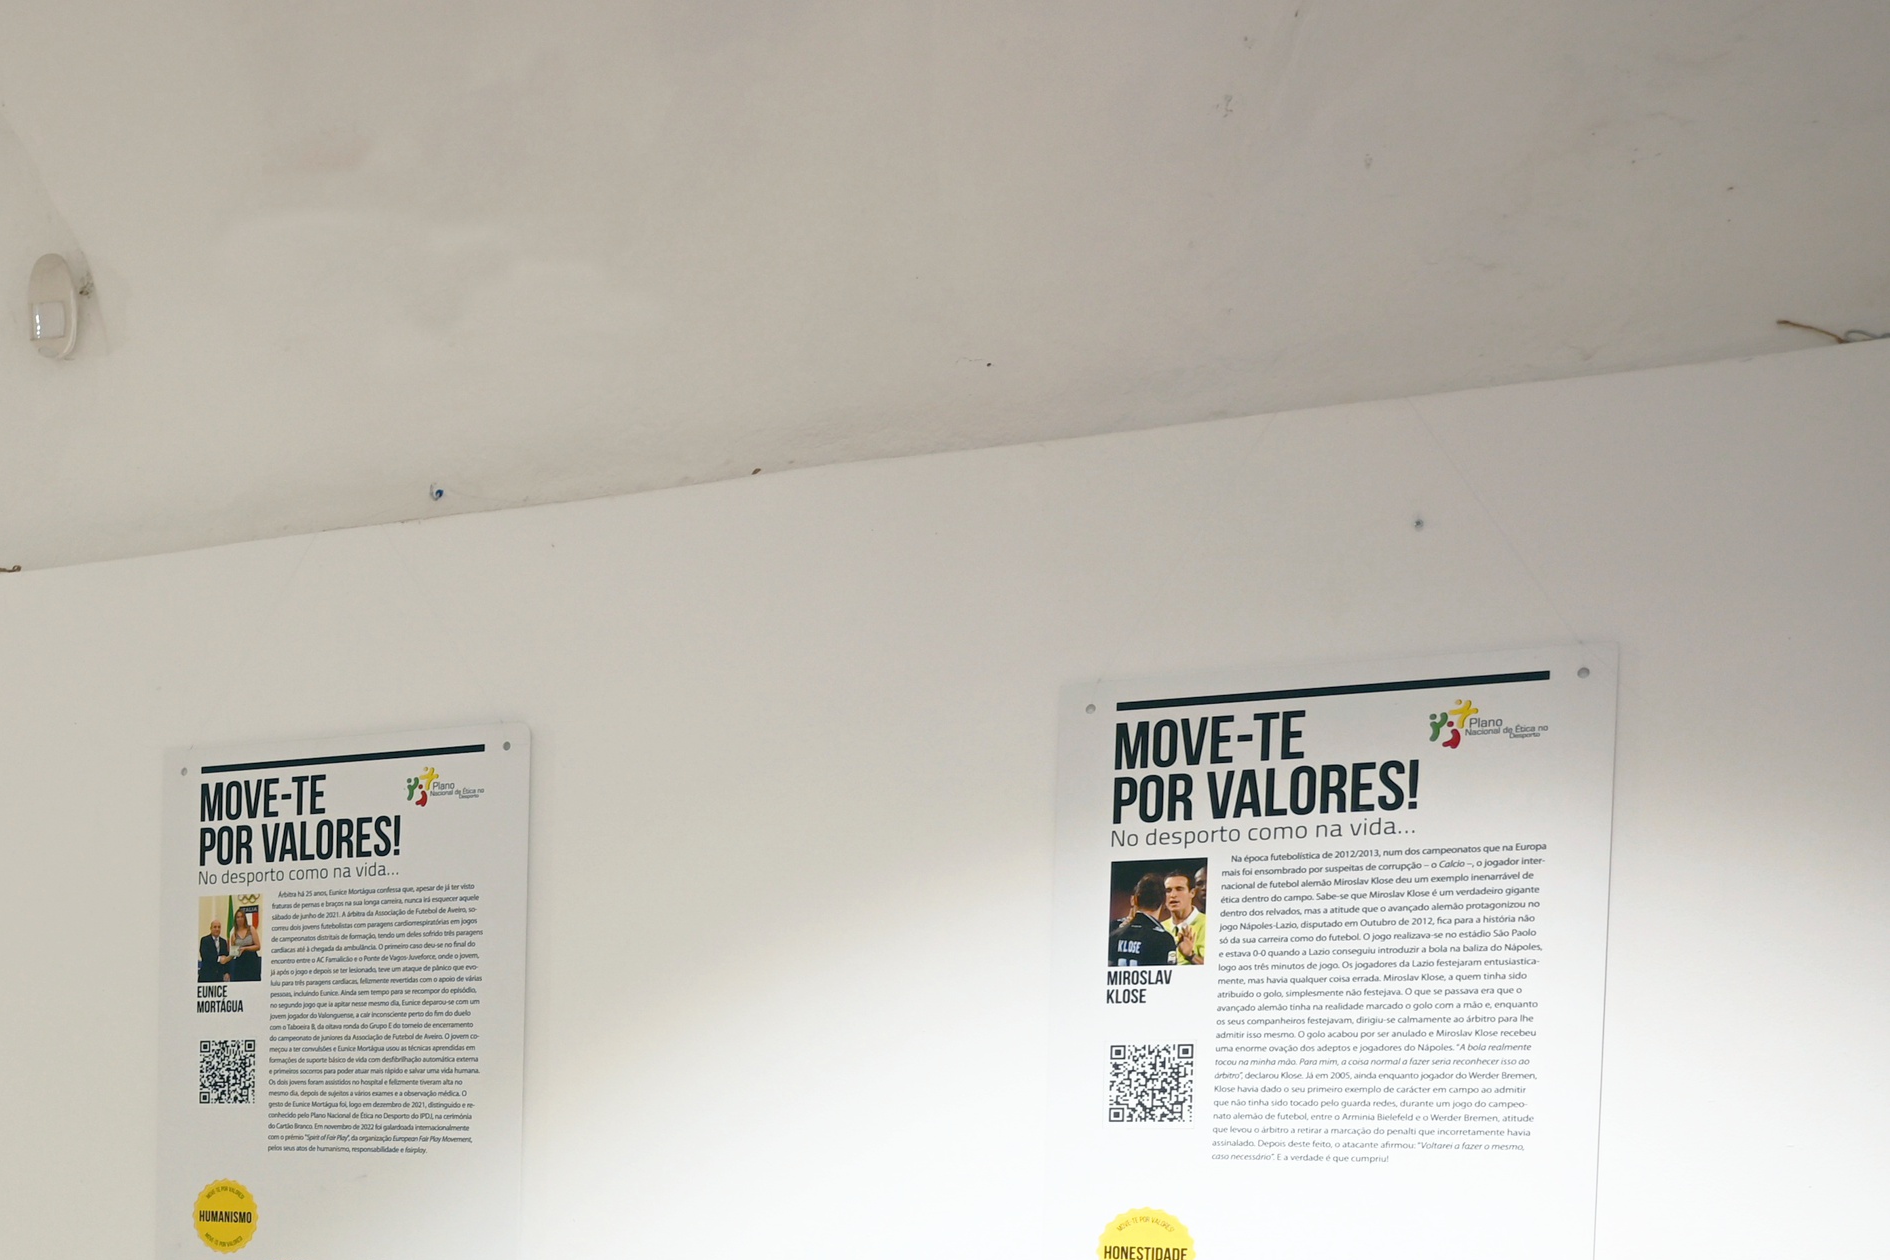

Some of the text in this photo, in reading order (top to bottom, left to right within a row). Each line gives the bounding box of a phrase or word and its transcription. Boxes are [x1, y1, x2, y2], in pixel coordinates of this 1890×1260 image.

[1465, 728, 1500, 736] Nacional
[1515, 724, 1535, 733] Ética
[1470, 718, 1503, 728] Plano
[1114, 710, 1306, 770] MOVE-TE
[433, 782, 455, 790] Plano
[1112, 759, 1419, 824] POR VALORES!
[200, 774, 326, 822] MOVE-TE
[1111, 818, 1415, 847] No desporto como na vida...
[199, 815, 401, 866] POR VALORES!
[1243, 855, 1269, 863] época
[1270, 852, 1320, 860] futebolística
[1334, 849, 1381, 858] 2012/2013,
[1404, 847, 1420, 855] dos
[1421, 846, 1482, 854] campeonatos
[1515, 843, 1547, 851] Europa
[198, 862, 398, 885] No desporto como na vida...
[1254, 866, 1307, 875] ensombrado
[1324, 865, 1364, 873] suspeitas
[1378, 862, 1422, 871] corrupção
[1438, 860, 1465, 868] Calcio
[1483, 858, 1520, 868] jogador
[1269, 880, 1299, 888] futebol
[1300, 879, 1332, 887] alemão
[1430, 874, 1469, 882] exemplo
[1470, 872, 1520, 880] inenarrável
[1522, 871, 1534, 879] de
[444, 884, 450, 892] já
[1270, 894, 1282, 902] do
[1316, 892, 1349, 900] Sabe-se
[1368, 890, 1405, 898] Miroslav
[1406, 889, 1430, 897] Klose
[1455, 887, 1504, 895] verdadeiro
[1505, 887, 1540, 896] gigante
[1118, 940, 1142, 954] KLOSE
[1107, 970, 1172, 986] MIROSLAV
[197, 985, 228, 998] EUNICE
[1106, 989, 1146, 1004] KLOSE
[197, 998, 244, 1013] MORTÁGUA
[199, 1210, 252, 1223] HUMANISMO
